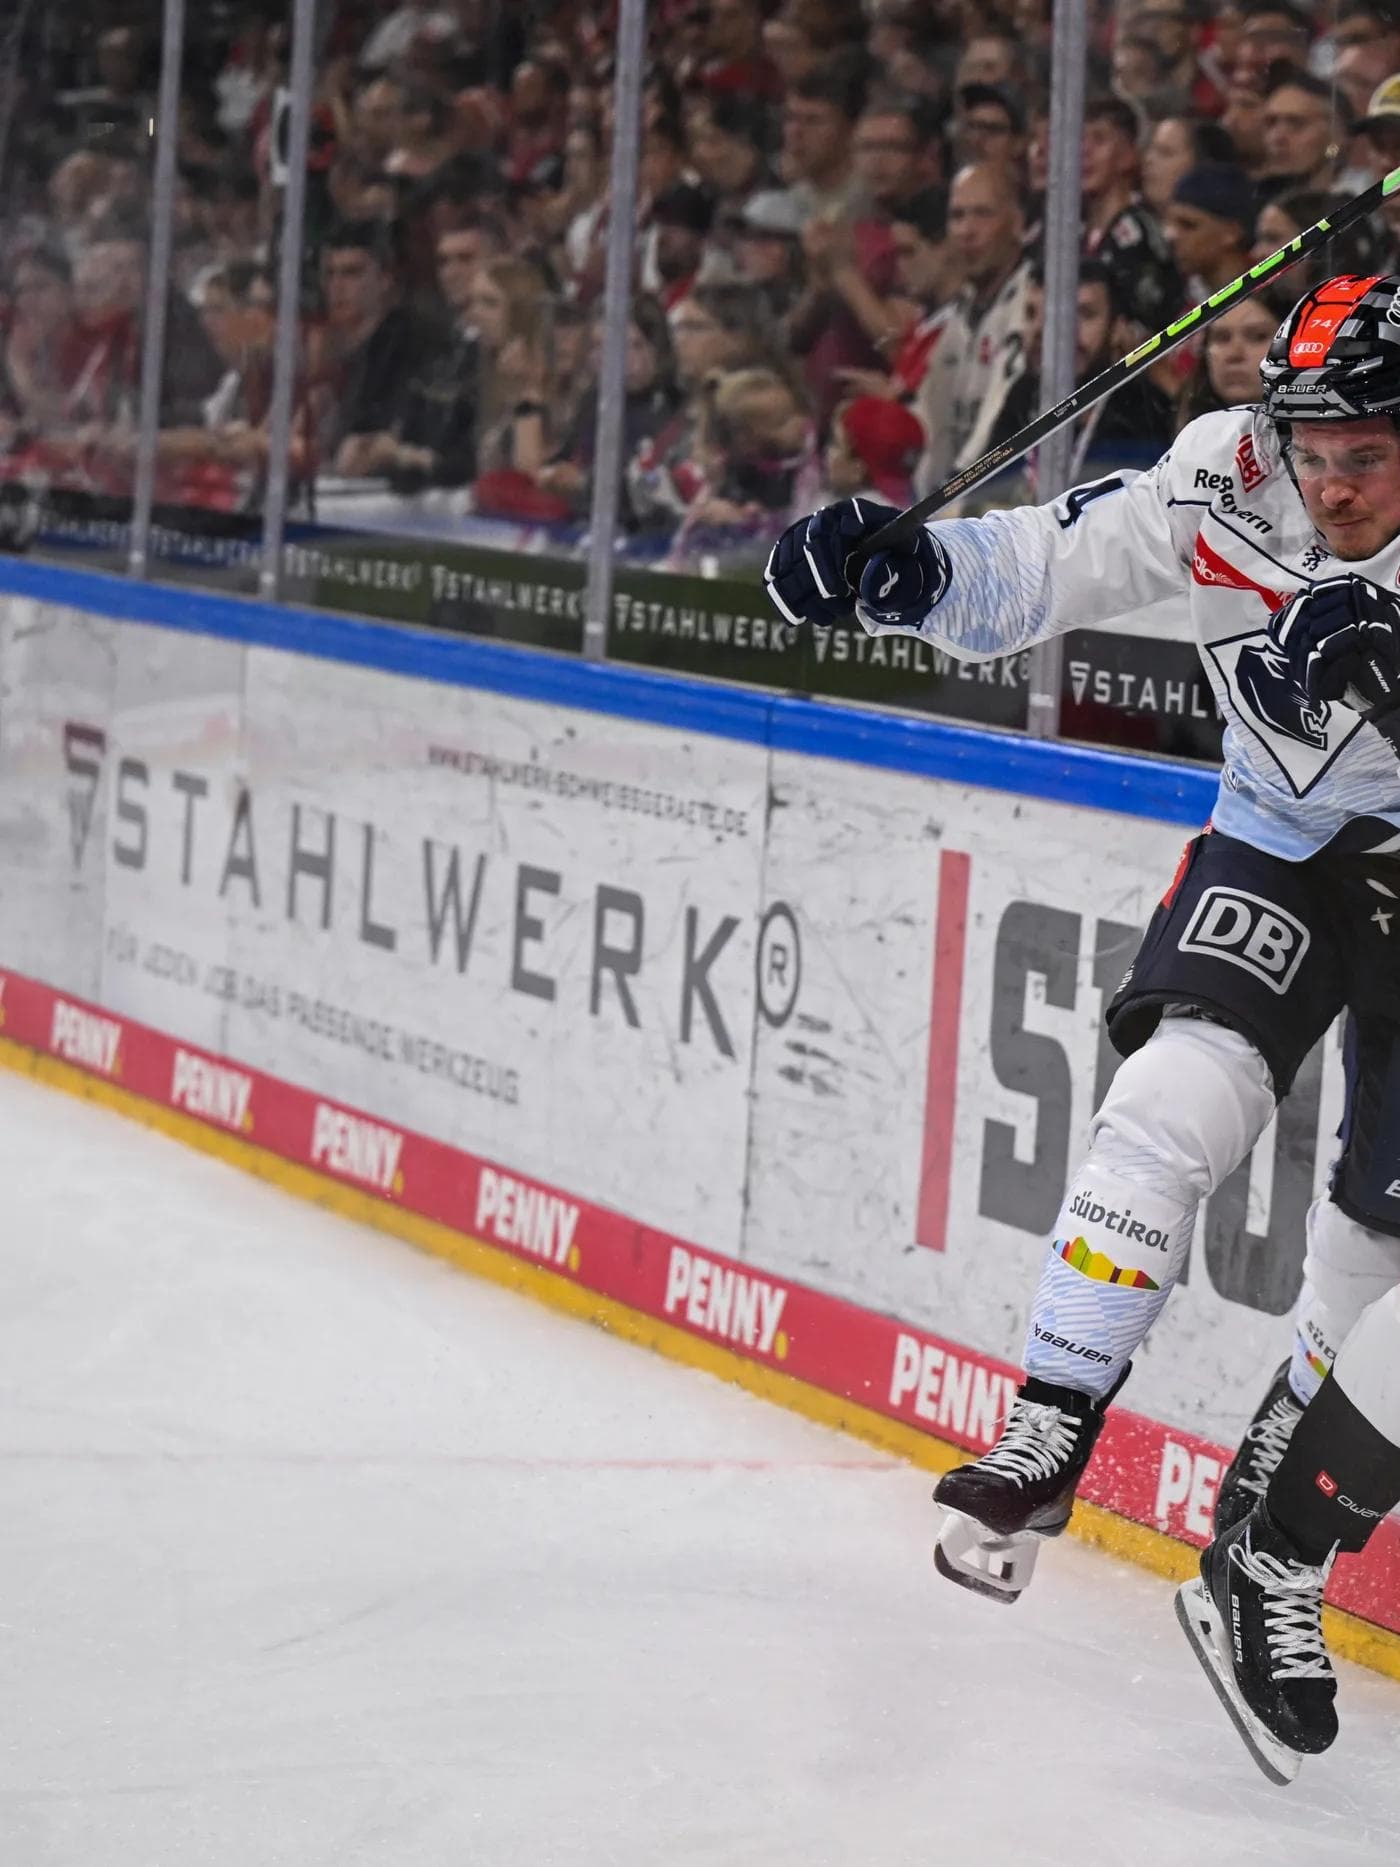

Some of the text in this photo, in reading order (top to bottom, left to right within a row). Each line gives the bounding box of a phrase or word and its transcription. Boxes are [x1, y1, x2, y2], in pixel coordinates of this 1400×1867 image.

[1311, 319, 1331, 328] 74
[1277, 385, 1327, 394] BAUER
[1095, 672, 1214, 718] STAHL
[1196, 897, 1294, 976] DB
[1040, 1331, 1113, 1366] BAUER
[1155, 1440, 1222, 1538] PE
[1231, 1593, 1243, 1663] BAUER
